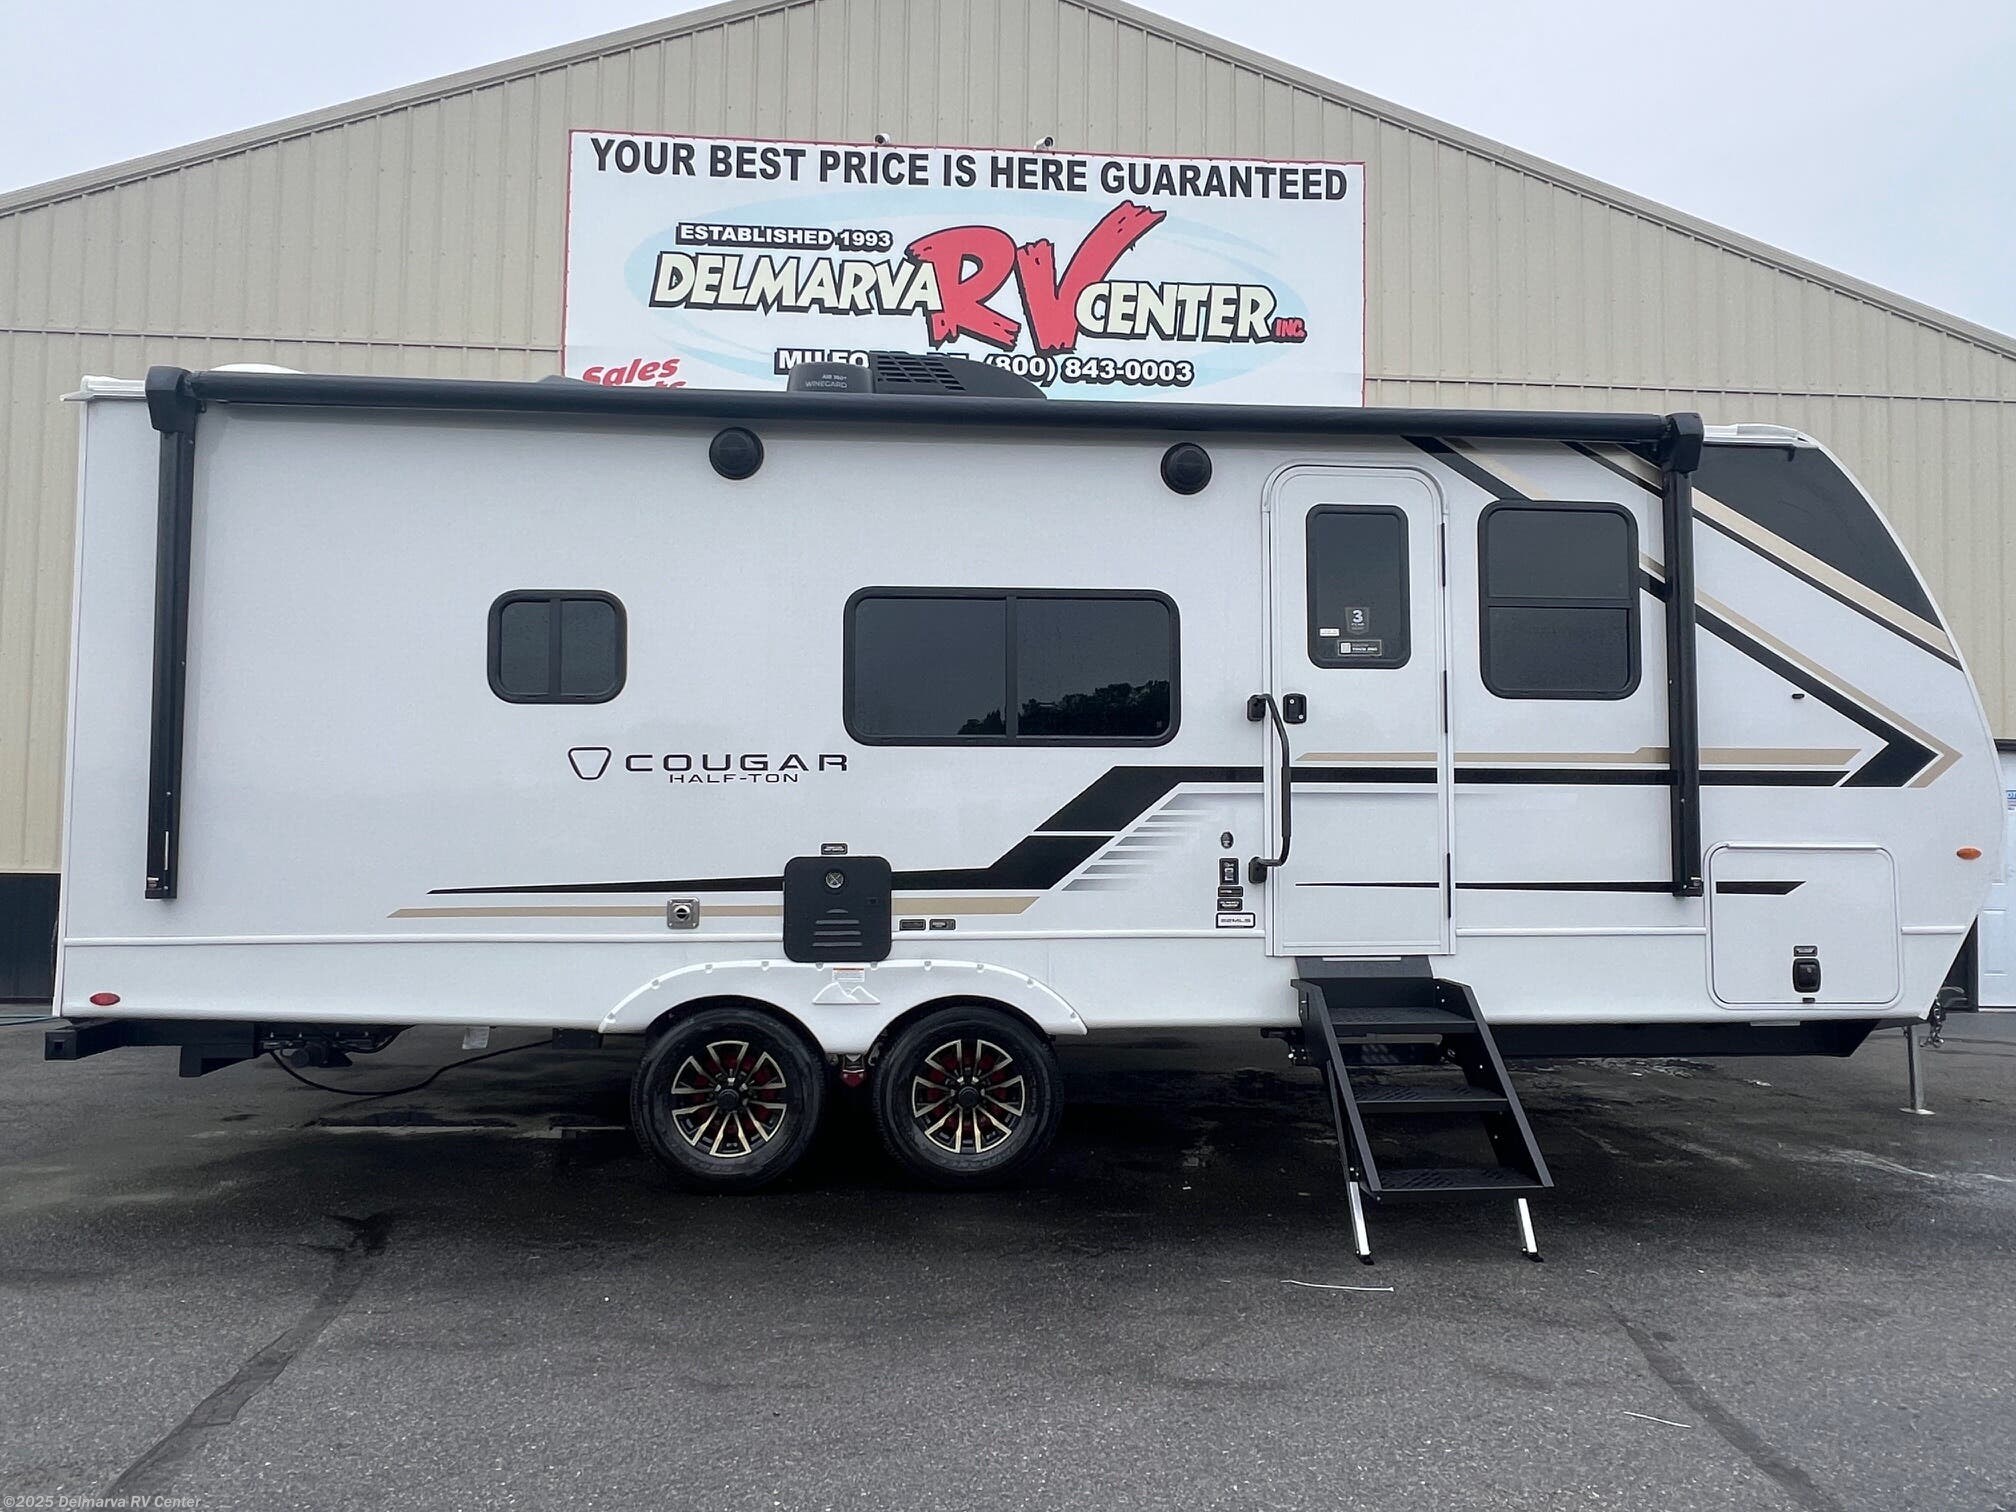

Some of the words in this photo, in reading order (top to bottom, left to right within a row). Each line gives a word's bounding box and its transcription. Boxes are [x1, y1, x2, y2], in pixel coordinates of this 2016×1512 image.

[590, 137, 696, 177] YOUR
[709, 144, 806, 182] BEST
[819, 150, 929, 186] PRICE
[942, 154, 977, 188] IS
[990, 155, 1087, 192] HERE
[1099, 161, 1348, 201] GUARANTEED
[677, 223, 834, 248] ESTABLISHED
[838, 230, 893, 249] 1993
[650, 251, 944, 314] DELMARVA
[905, 200, 1167, 355] RV
[1074, 281, 1277, 342] CENTER
[1273, 318, 1308, 343] INC.
[984, 353, 1059, 387] (800)
[1062, 356, 1194, 387] 843-0003
[625, 753, 848, 772] COUGAR
[669, 774, 799, 784] HALF-TON
